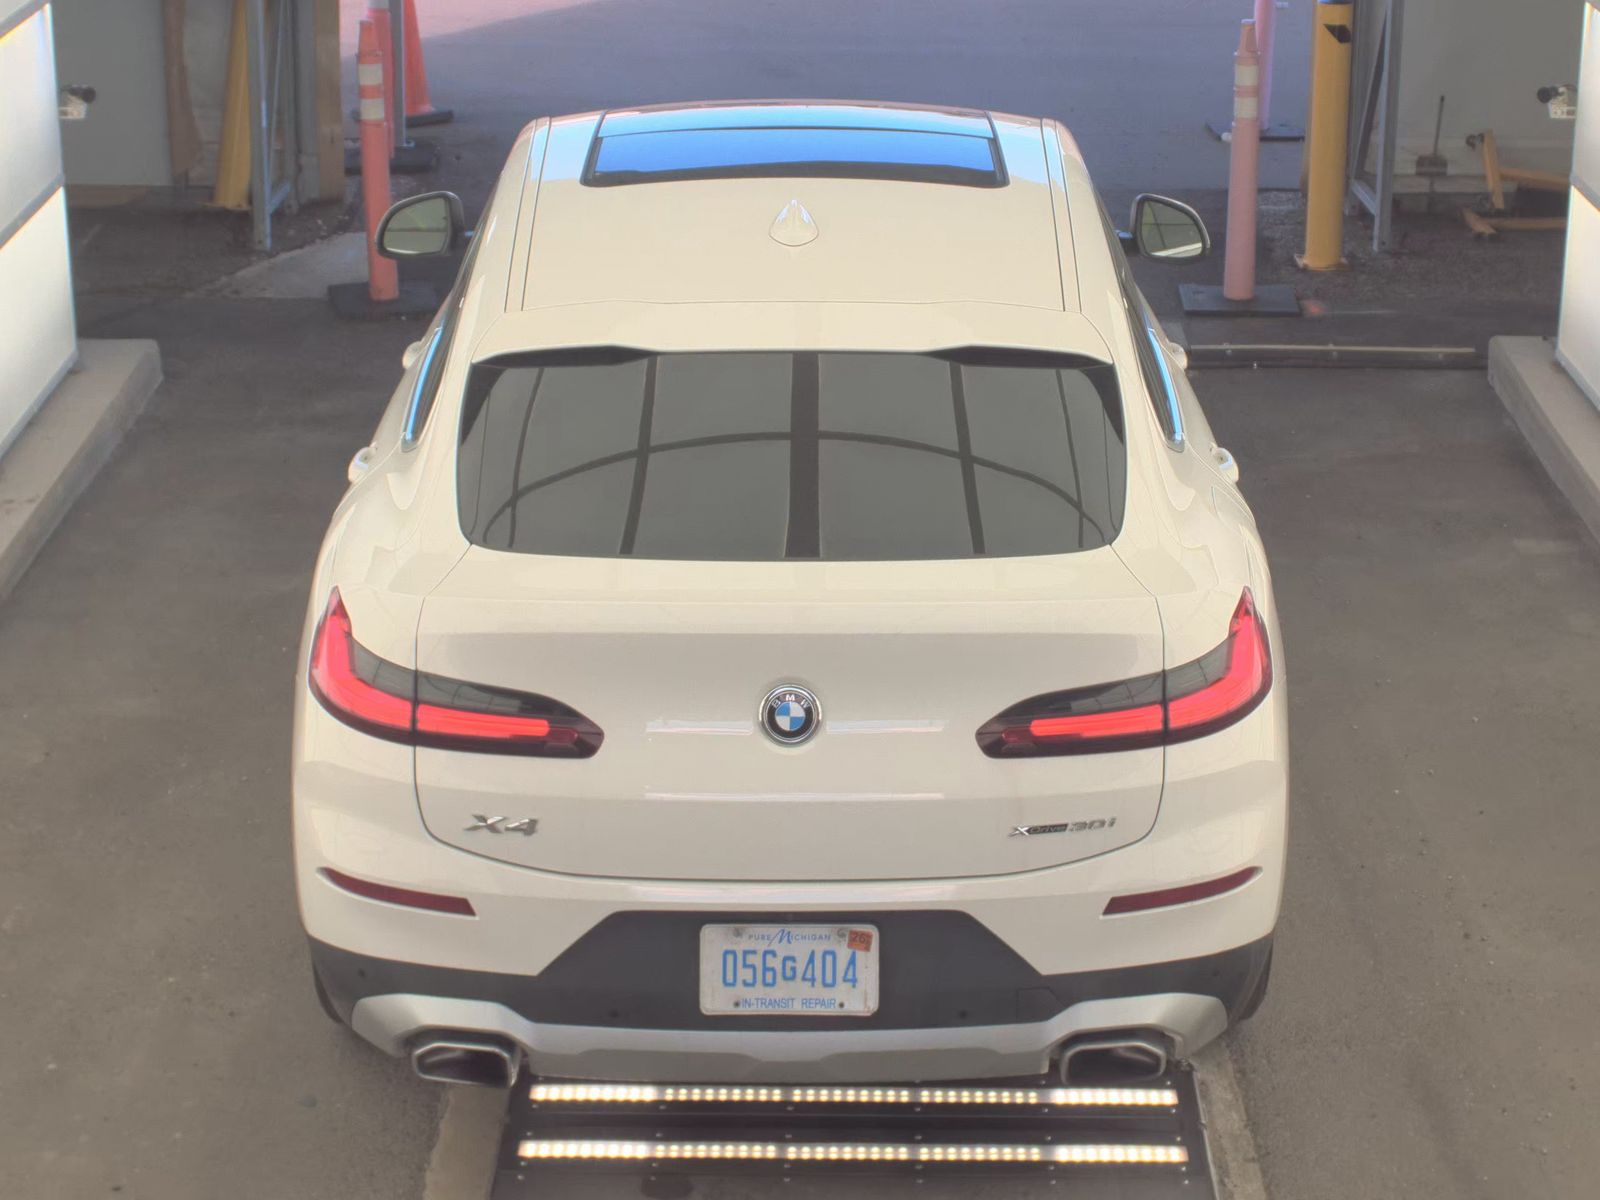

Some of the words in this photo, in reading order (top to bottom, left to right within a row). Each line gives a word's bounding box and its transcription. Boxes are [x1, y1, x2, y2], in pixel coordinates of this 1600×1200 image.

[771, 693, 811, 709] BMW
[463, 814, 538, 836] X4
[722, 949, 858, 989] 056G404
[741, 997, 795, 1009] IN-TRANSIT
[801, 997, 837, 1009] REPAIR
